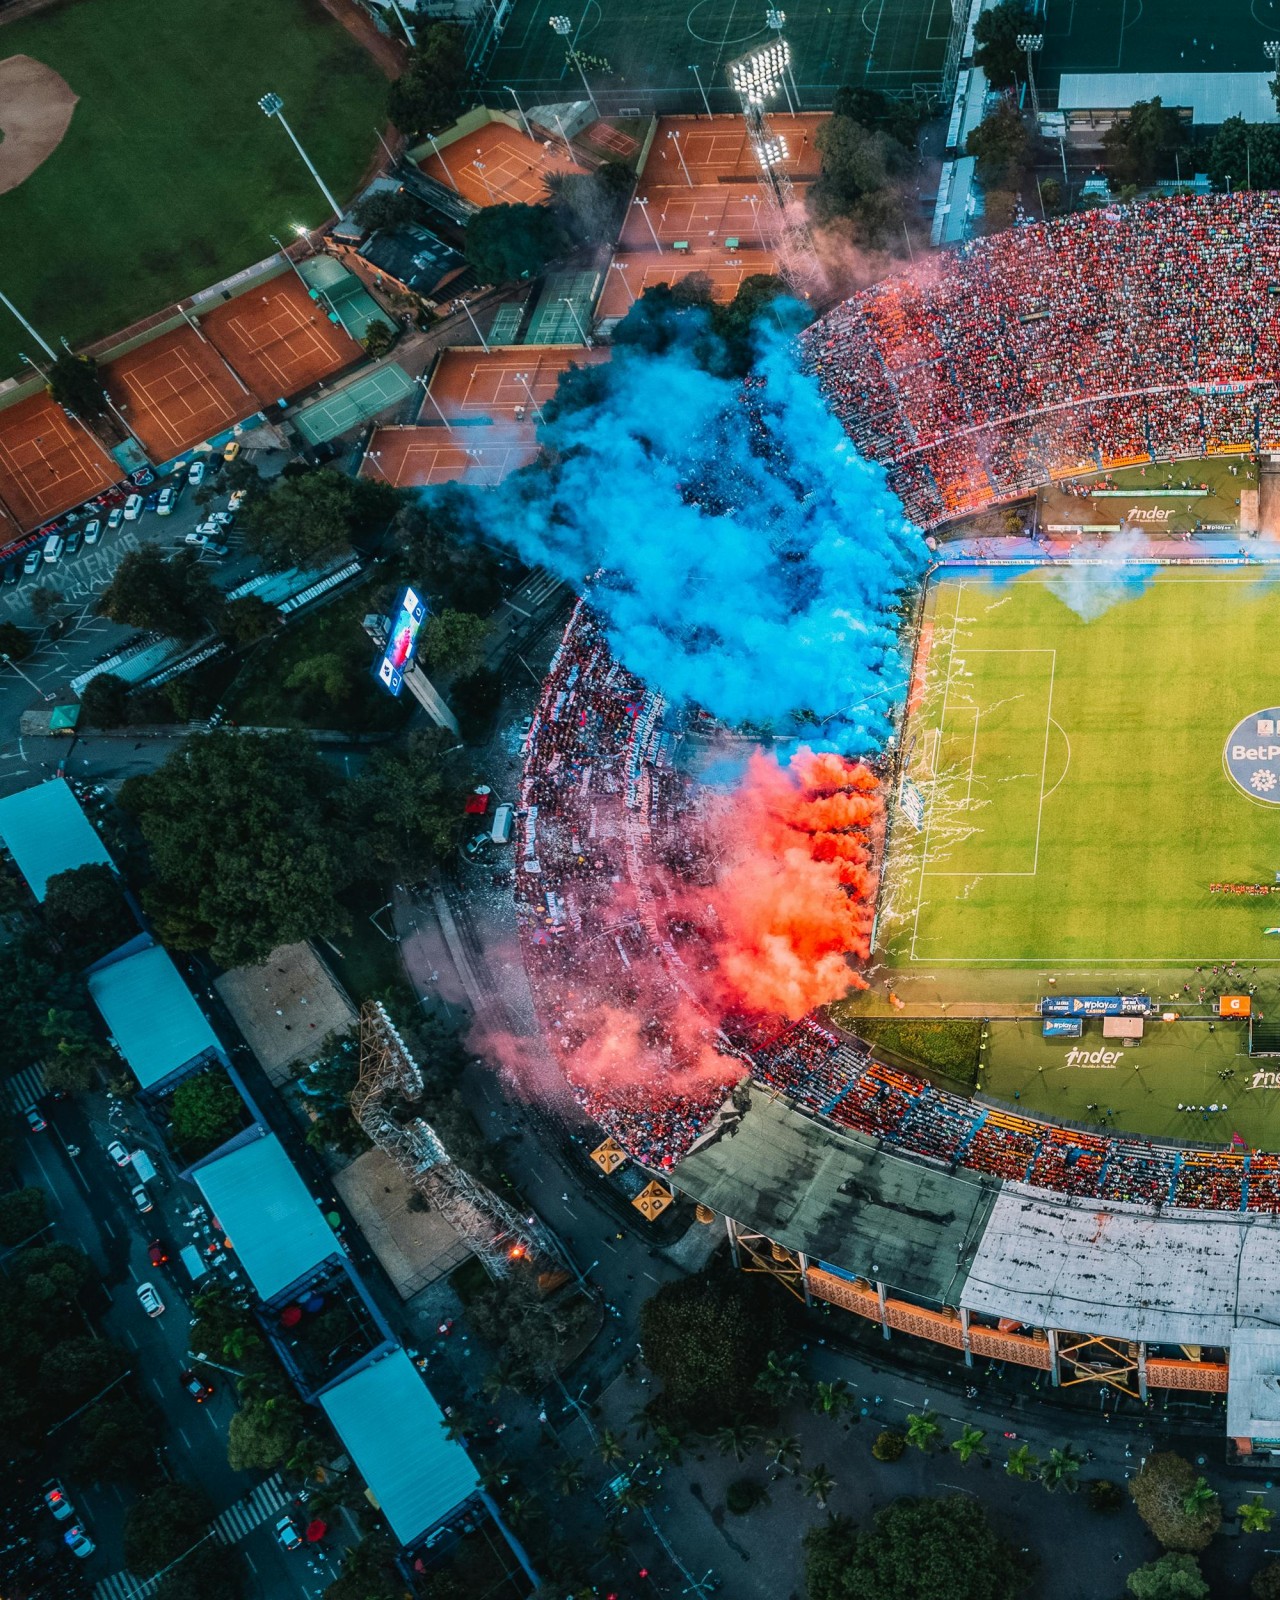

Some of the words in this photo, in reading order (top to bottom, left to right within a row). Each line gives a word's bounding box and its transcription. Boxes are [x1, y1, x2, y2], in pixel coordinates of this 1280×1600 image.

[1128, 505, 1176, 521] inder
[1230, 999, 1240, 1008] G
[1064, 1046, 1124, 1066] inder
